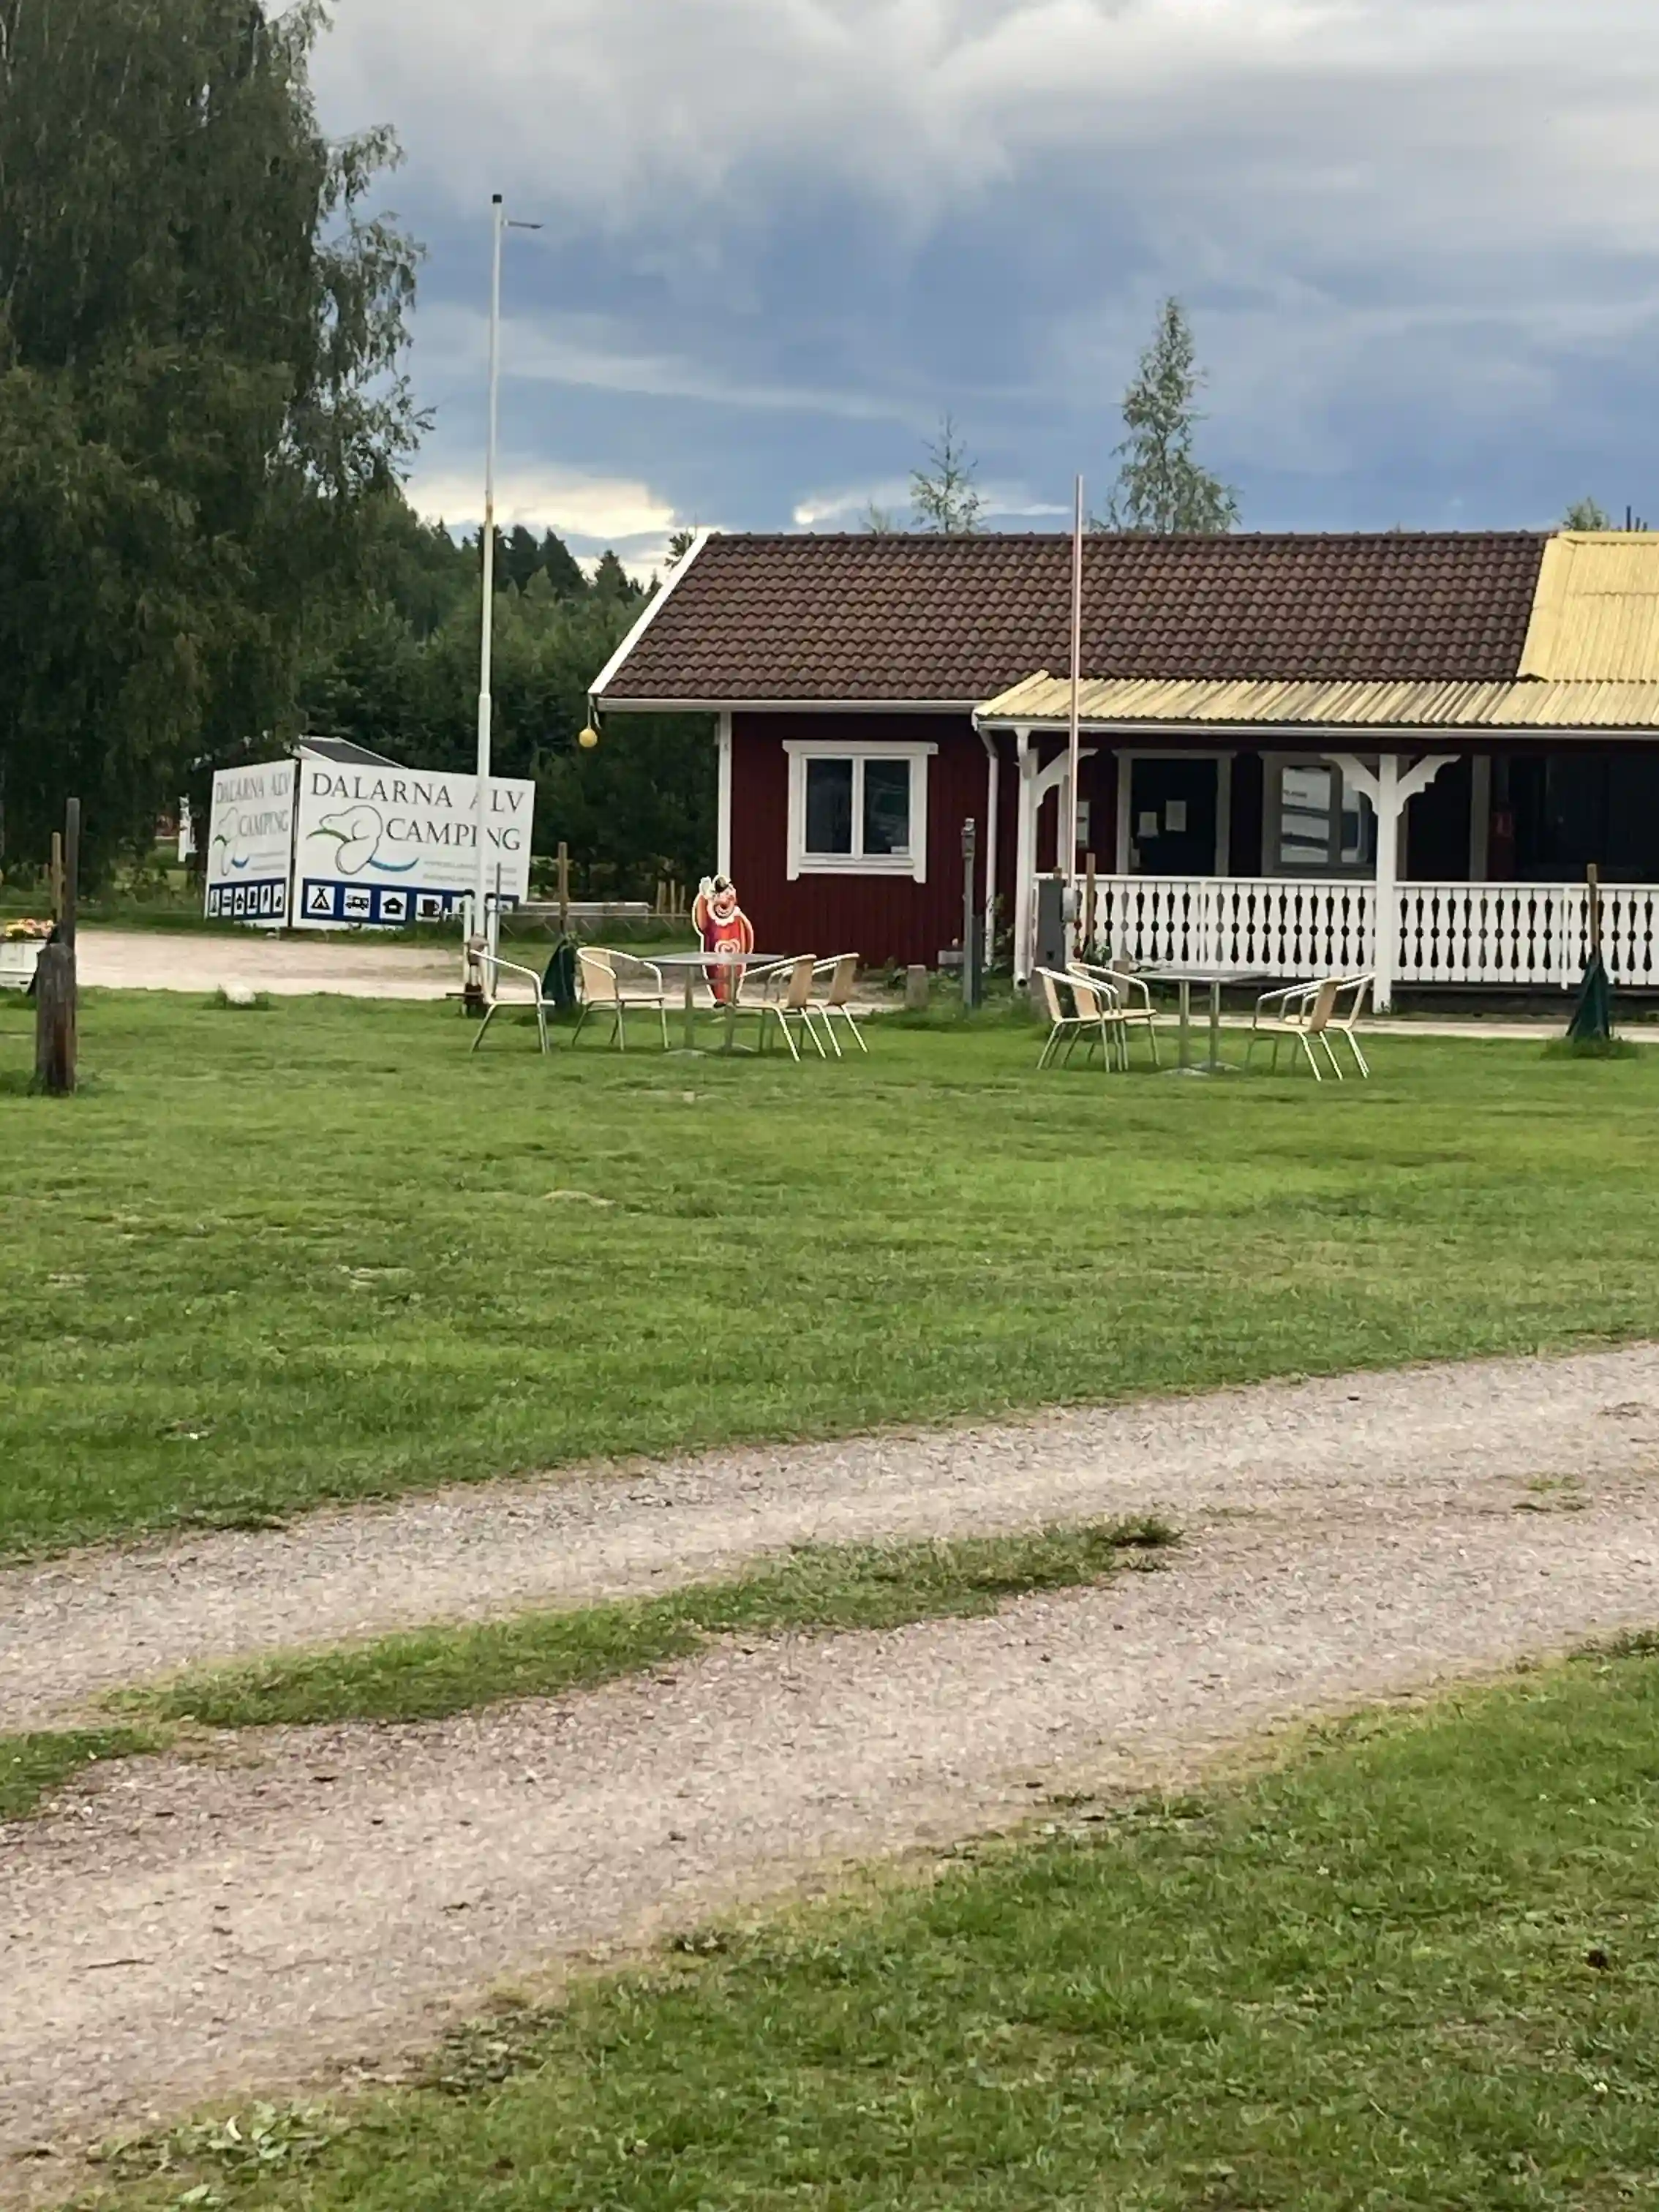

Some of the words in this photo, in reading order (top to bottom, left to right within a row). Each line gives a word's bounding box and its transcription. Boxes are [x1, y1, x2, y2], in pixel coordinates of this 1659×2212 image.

[216, 778, 264, 803] DALARNA
[311, 772, 453, 808] DALARNA
[239, 810, 288, 837] CAMPING
[386, 818, 521, 850] CAMPING
